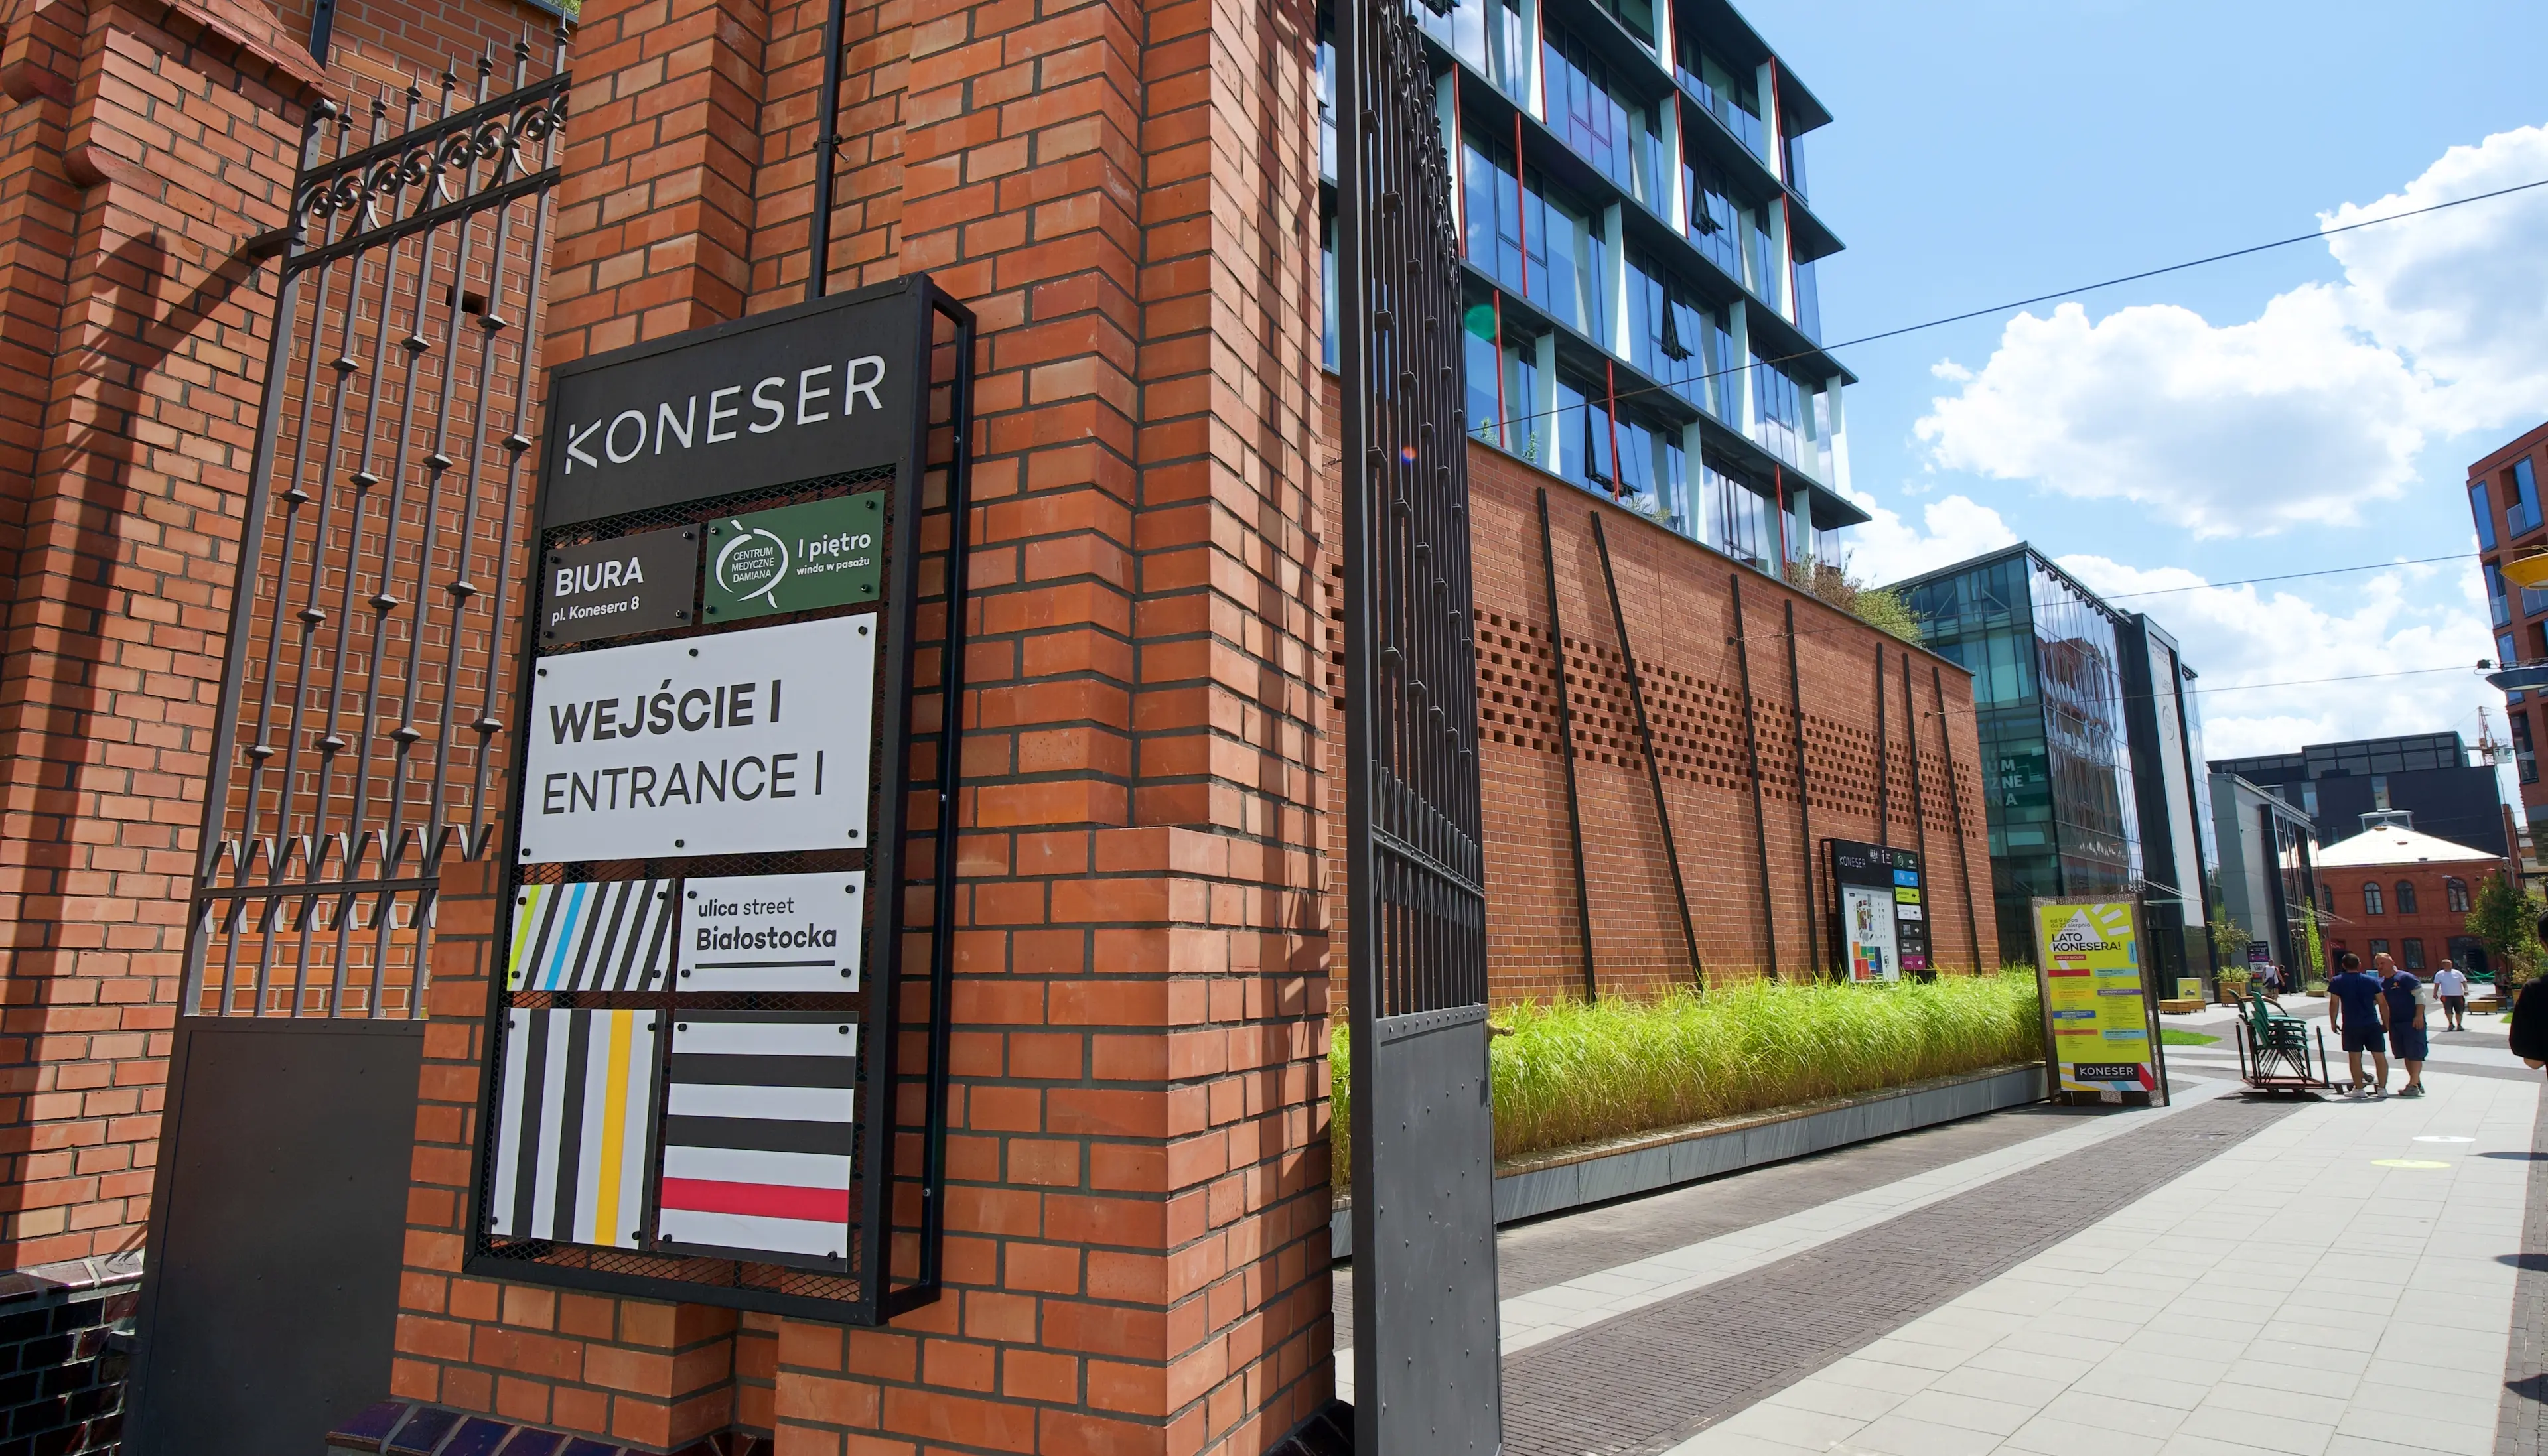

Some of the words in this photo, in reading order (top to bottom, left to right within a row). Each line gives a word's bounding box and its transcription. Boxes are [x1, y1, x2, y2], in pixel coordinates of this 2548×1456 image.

[565, 355, 886, 474] KONESER
[733, 547, 774, 561] CENTRUM
[798, 539, 804, 558] I
[809, 533, 871, 563] piętro
[731, 557, 774, 572] MEDYCZNE
[796, 564, 825, 575] winda
[835, 557, 870, 572] pasażu
[555, 557, 644, 597] BIURA
[733, 569, 772, 583] DAMIANA
[551, 607, 566, 626] pl.
[569, 601, 628, 620] Konesera
[630, 596, 640, 610] 8
[550, 679, 756, 744] WEJŚCIE
[770, 679, 782, 723] I
[543, 752, 798, 815] ENTRANCE
[815, 750, 823, 795] I
[1839, 856, 1866, 868] KONESER
[698, 898, 738, 917] ulica
[743, 897, 794, 915] street
[697, 923, 837, 951] Białostocka
[2052, 933, 2082, 942] LATO
[2052, 941, 2121, 951] KONESERA!
[2079, 1067, 2134, 1075] KONESER
